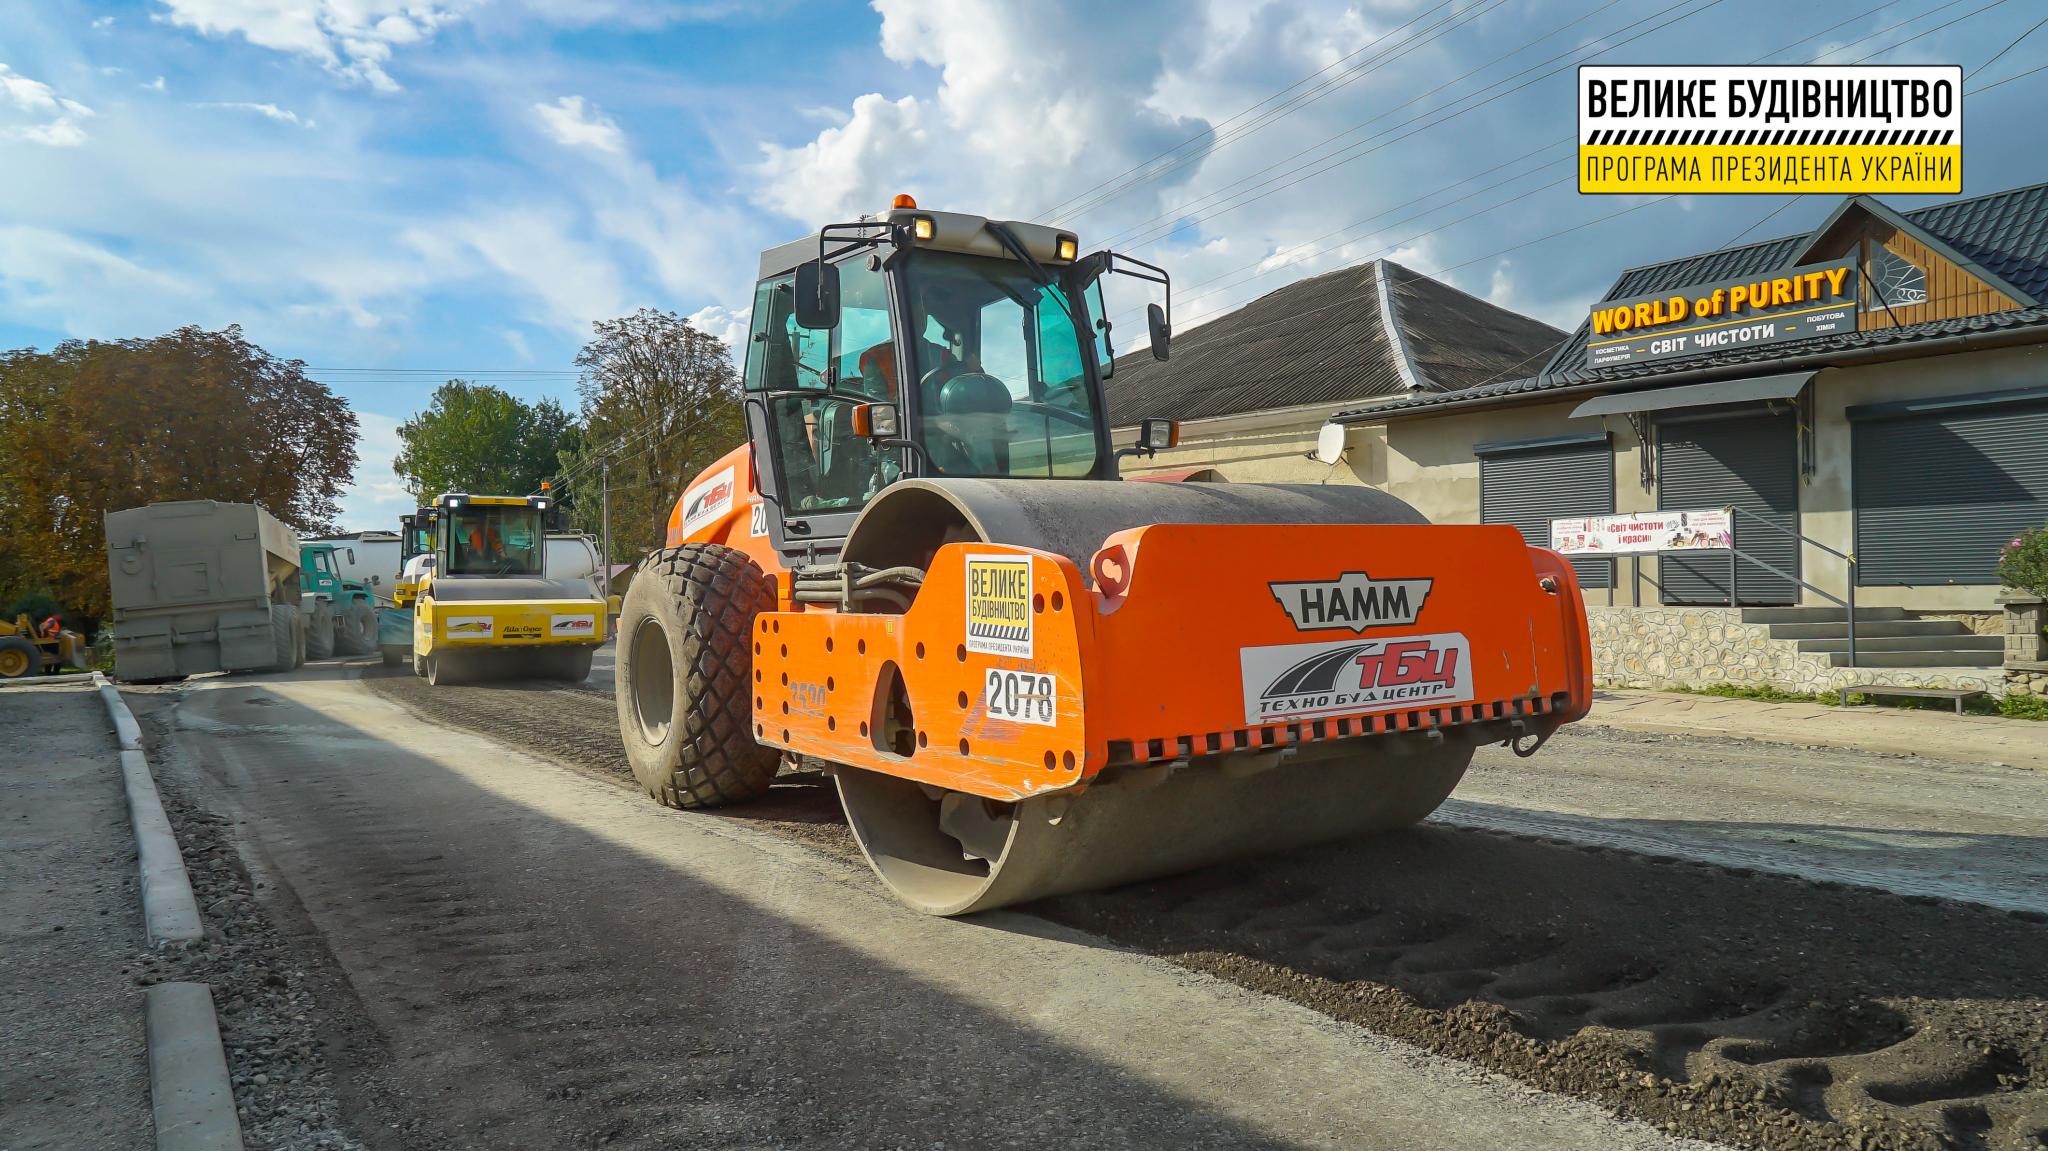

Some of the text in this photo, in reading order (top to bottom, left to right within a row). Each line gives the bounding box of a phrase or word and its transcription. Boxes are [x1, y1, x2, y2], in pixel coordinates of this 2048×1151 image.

[1592, 267, 1849, 335] WORLD of PURITY
[1806, 311, 1845, 323] ПОБУТОВА
[1650, 323, 1775, 355] СВІТ ЧИСТОТИ
[971, 568, 1026, 600] ВЕЛИКЕ
[972, 599, 1026, 622] БУДІВНИЦТВО
[1300, 585, 1411, 624] HAMM
[1355, 639, 1459, 690] ТБЦ
[988, 670, 1053, 723] 2078
[1259, 684, 1443, 713] ТЕХНО БУД ЦЕНТР
